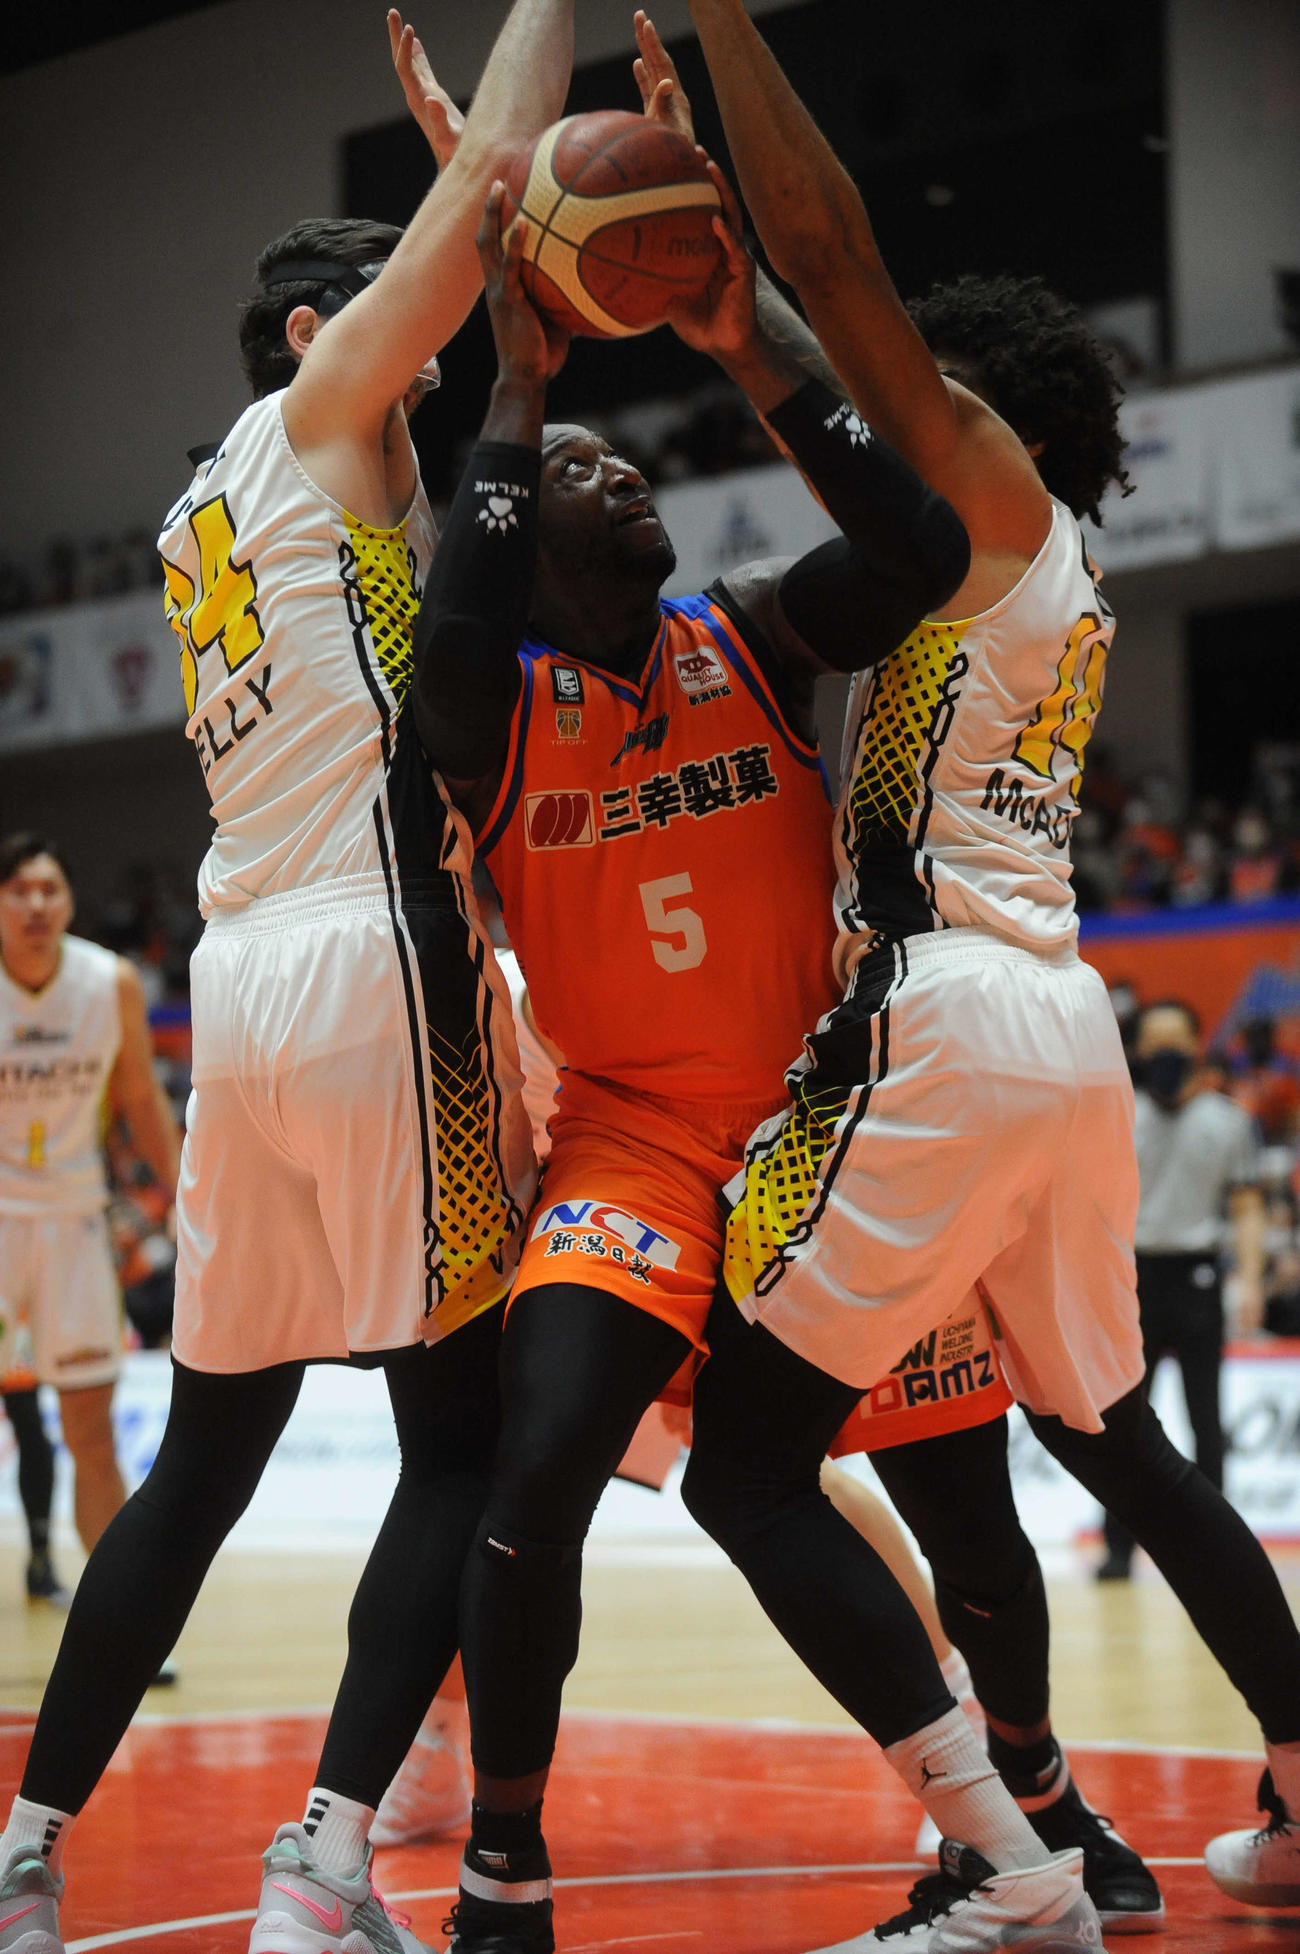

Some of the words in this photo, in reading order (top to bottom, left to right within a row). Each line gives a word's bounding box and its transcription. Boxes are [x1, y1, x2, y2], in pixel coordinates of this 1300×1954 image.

[474, 480, 529, 498] KELME
[700, 672, 724, 687] HOUSE
[600, 744, 779, 840] 三幸製菓
[638, 871, 708, 973] 5
[541, 1202, 670, 1254] NCT
